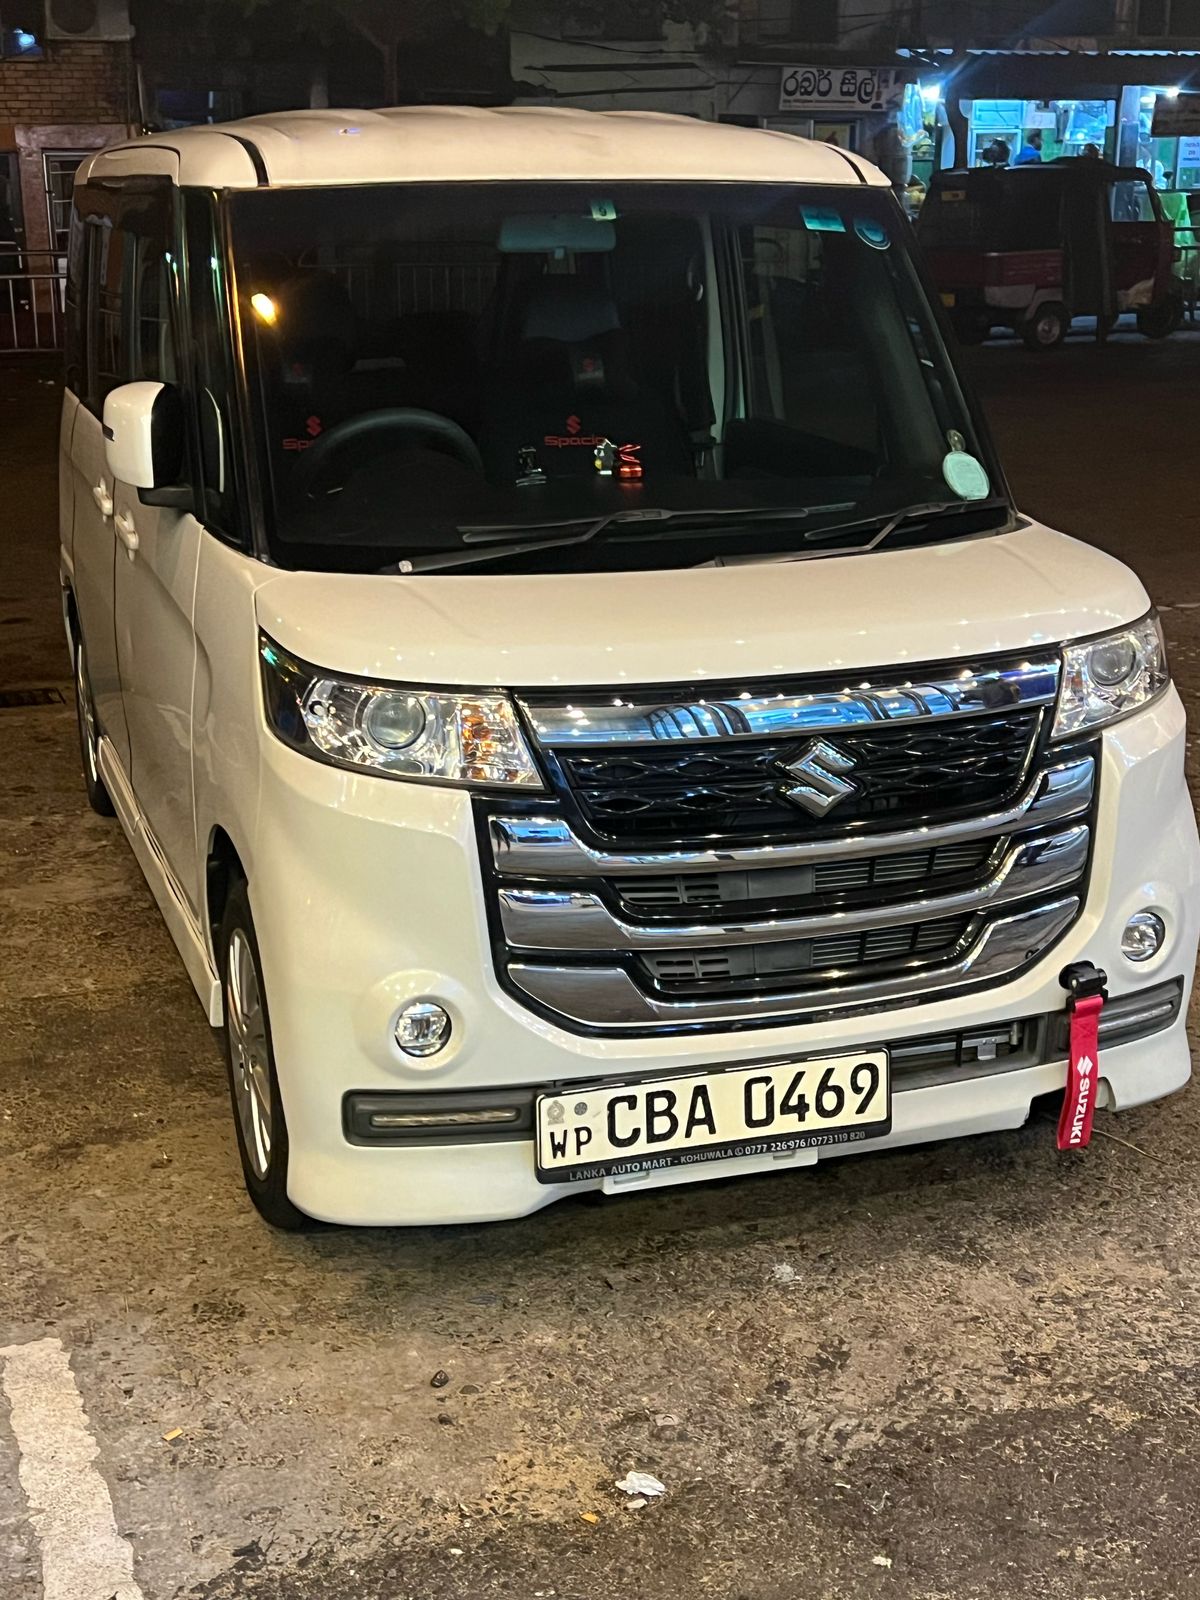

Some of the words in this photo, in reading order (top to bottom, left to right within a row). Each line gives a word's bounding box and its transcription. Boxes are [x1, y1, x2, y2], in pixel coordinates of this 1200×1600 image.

[783, 69, 832, 97] රබර්
[549, 1126, 592, 1159] WP
[606, 1084, 717, 1148] CBA
[744, 1062, 880, 1129] 0469
[1070, 1078, 1090, 1144] SUZUKI
[569, 1167, 607, 1181] LANKA
[610, 1162, 641, 1175] AUTO
[642, 1157, 673, 1170] MART
[680, 1149, 734, 1164] KOHUWALA
[745, 1144, 768, 1155] 0777
